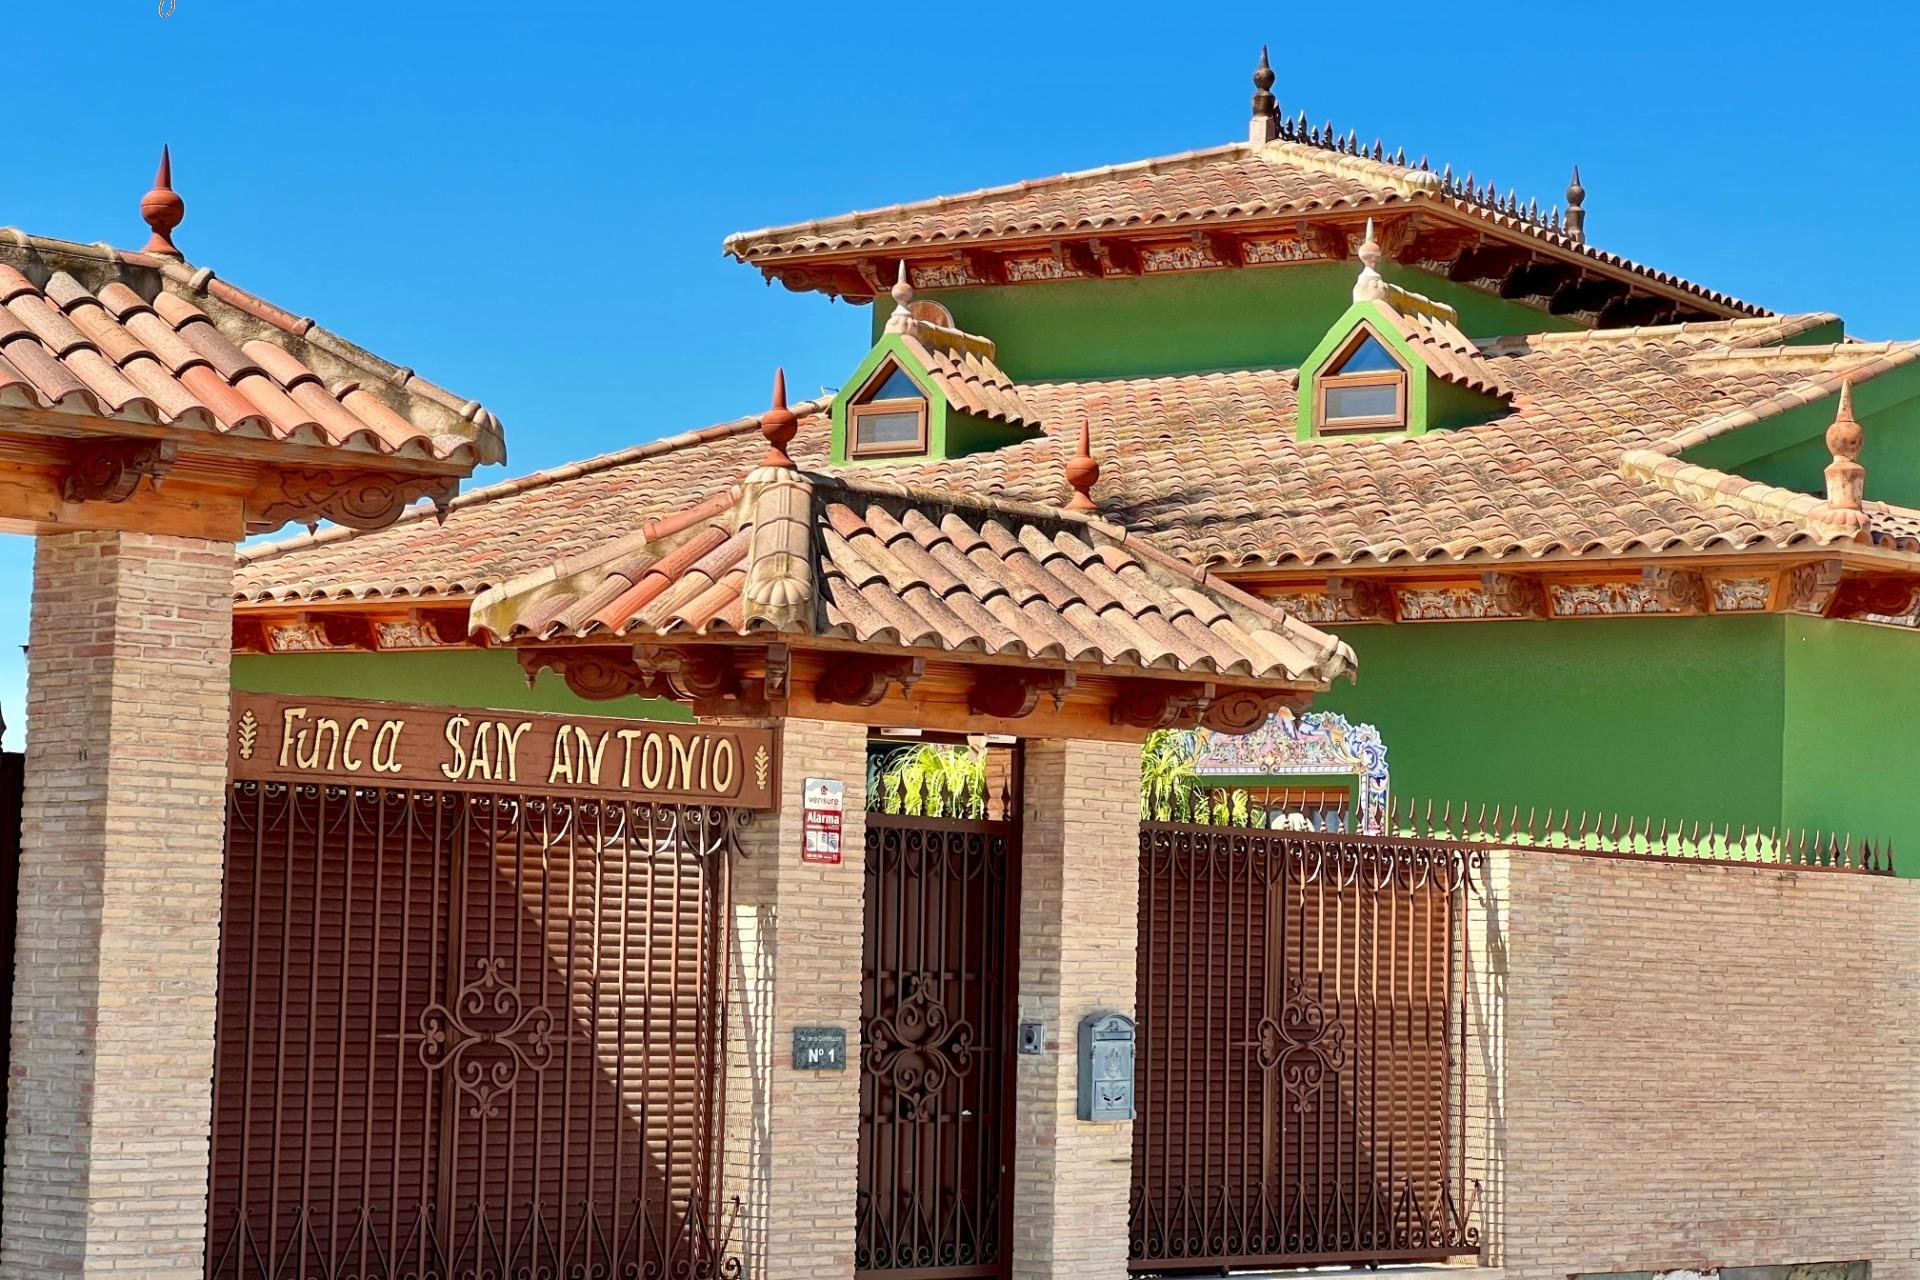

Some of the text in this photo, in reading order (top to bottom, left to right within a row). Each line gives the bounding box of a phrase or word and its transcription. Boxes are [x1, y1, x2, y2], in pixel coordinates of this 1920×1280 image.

[279, 707, 405, 773] Finca
[808, 796, 839, 806] verisure
[807, 811, 840, 825] Alarma
[828, 1048, 835, 1063] 1
